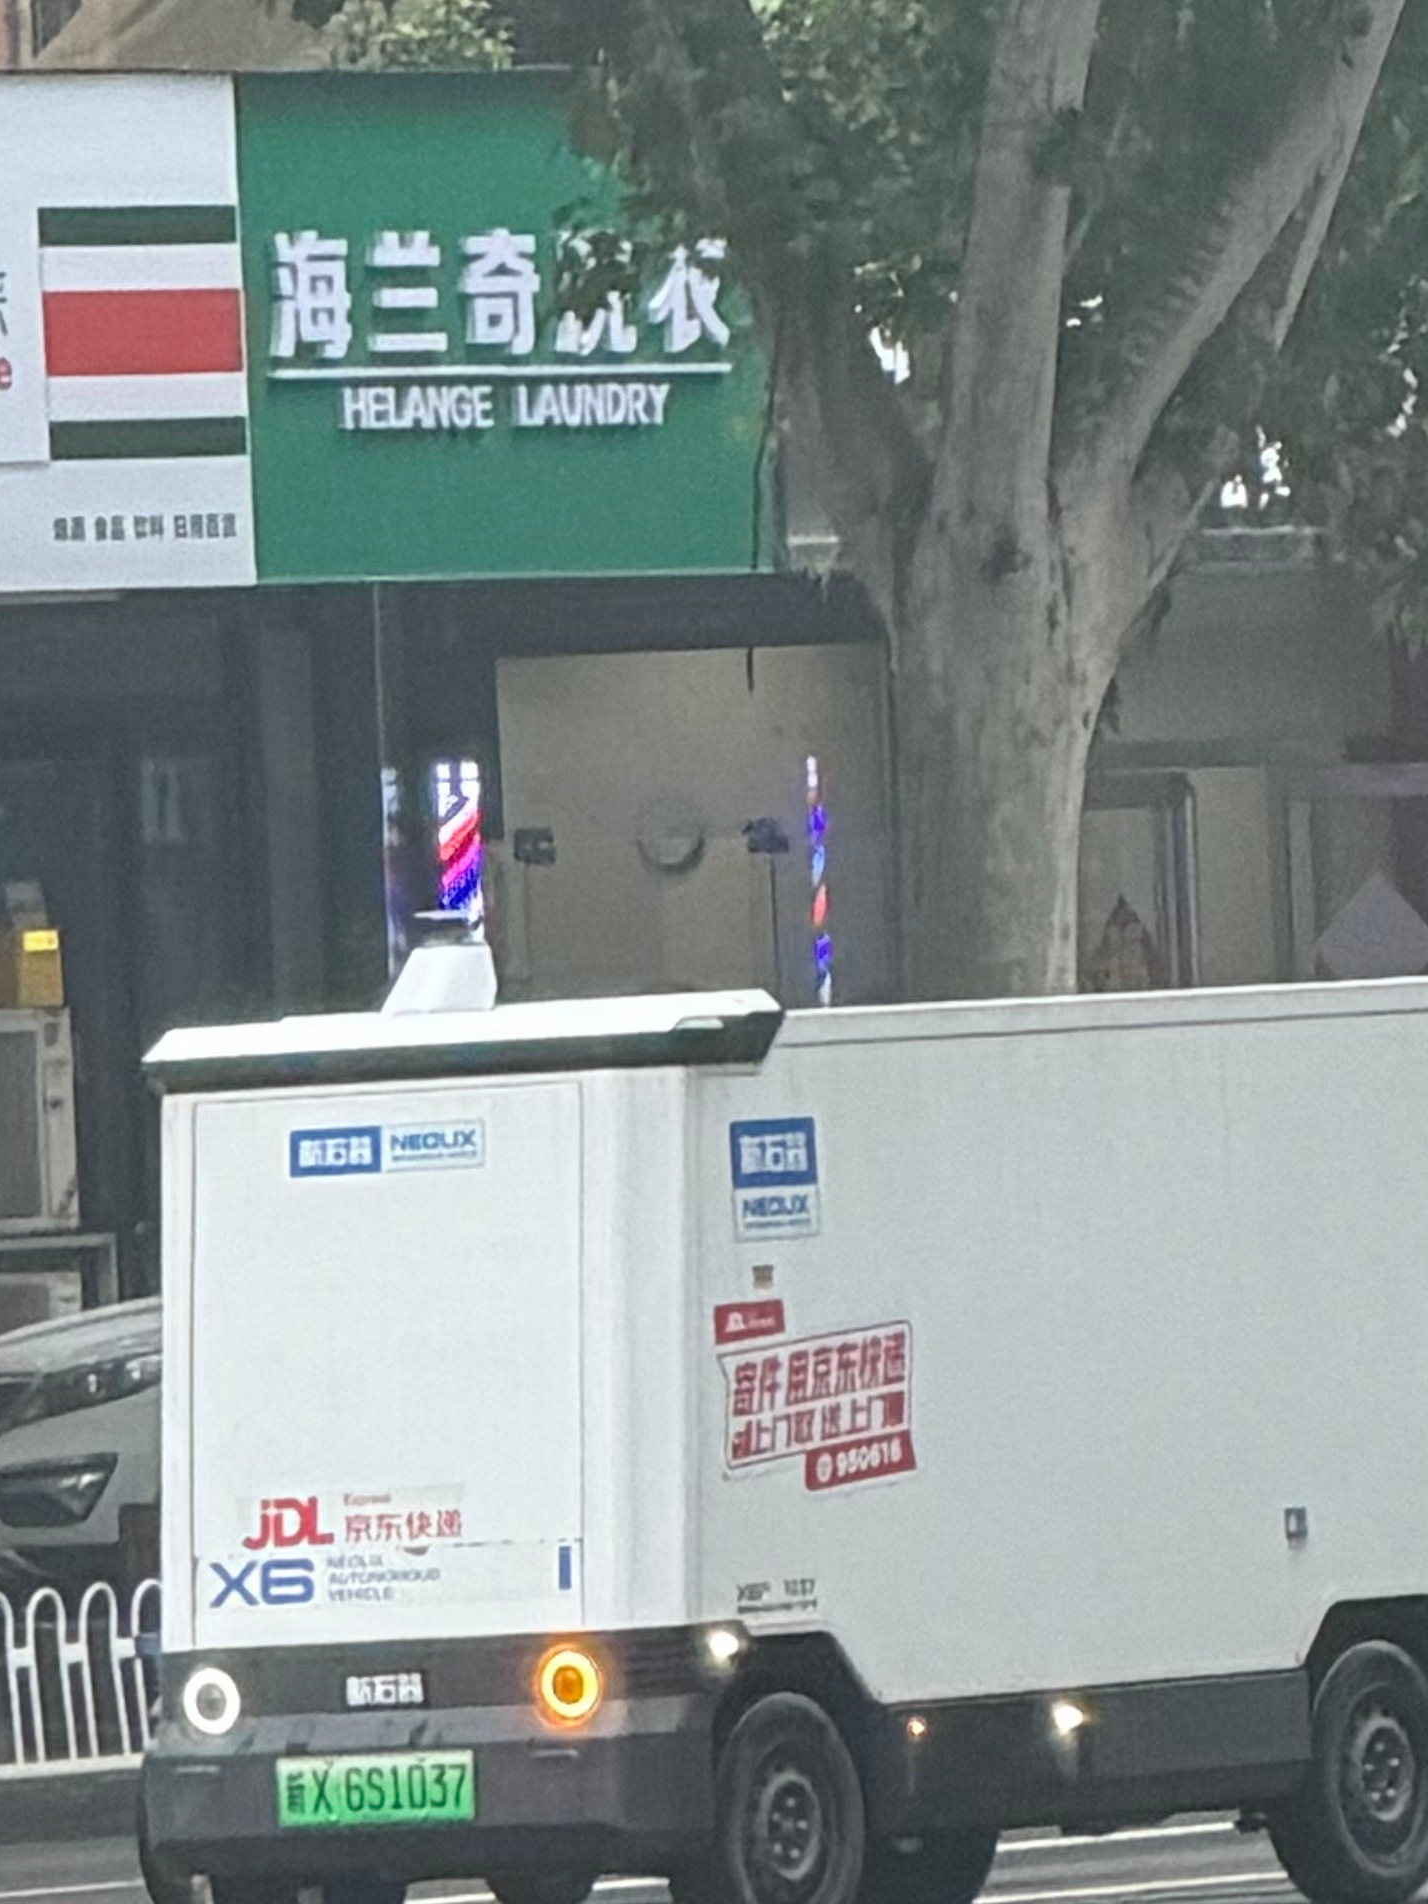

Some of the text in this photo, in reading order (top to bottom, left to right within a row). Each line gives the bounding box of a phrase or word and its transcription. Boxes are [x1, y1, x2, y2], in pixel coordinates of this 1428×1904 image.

[340, 383, 670, 430] HELANGE LAUNDRY
[345, 1509, 462, 1543] 京东快递
[209, 1558, 315, 1609] X6
